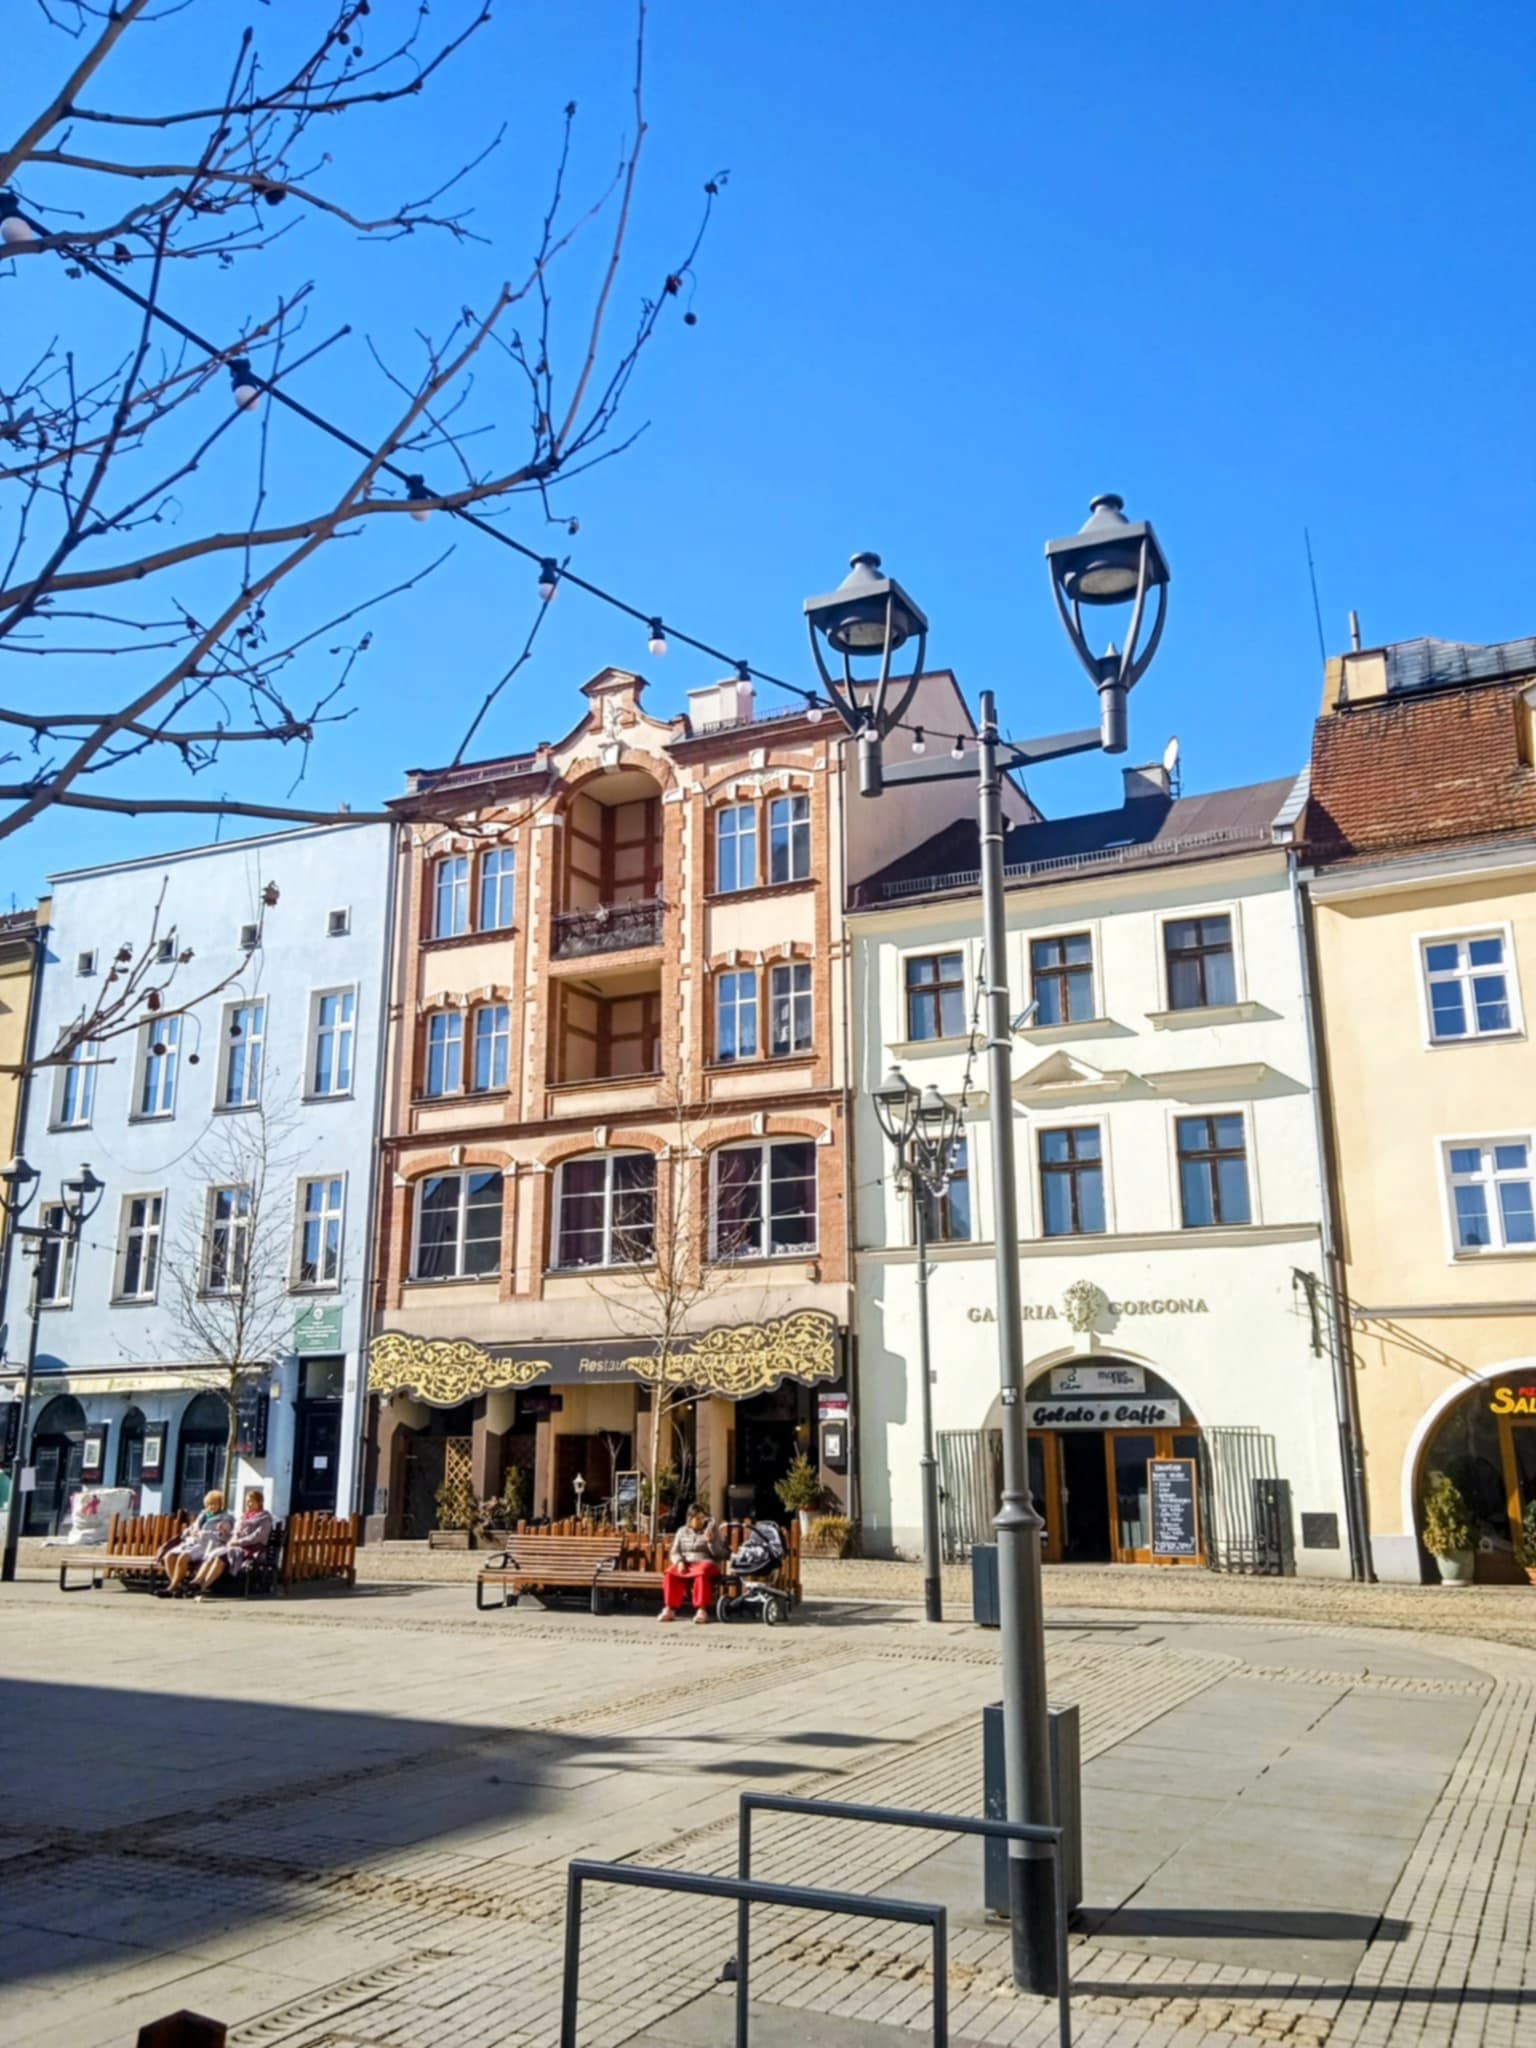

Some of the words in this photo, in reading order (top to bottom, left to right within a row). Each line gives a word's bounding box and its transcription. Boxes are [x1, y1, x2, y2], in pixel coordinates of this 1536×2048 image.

[967, 1305, 1058, 1323] GARIA
[1108, 1298, 1209, 1316] GORGONA
[1033, 1405, 1095, 1426] Gelato
[1099, 1411, 1109, 1422] e
[1115, 1404, 1166, 1425] Caffe
